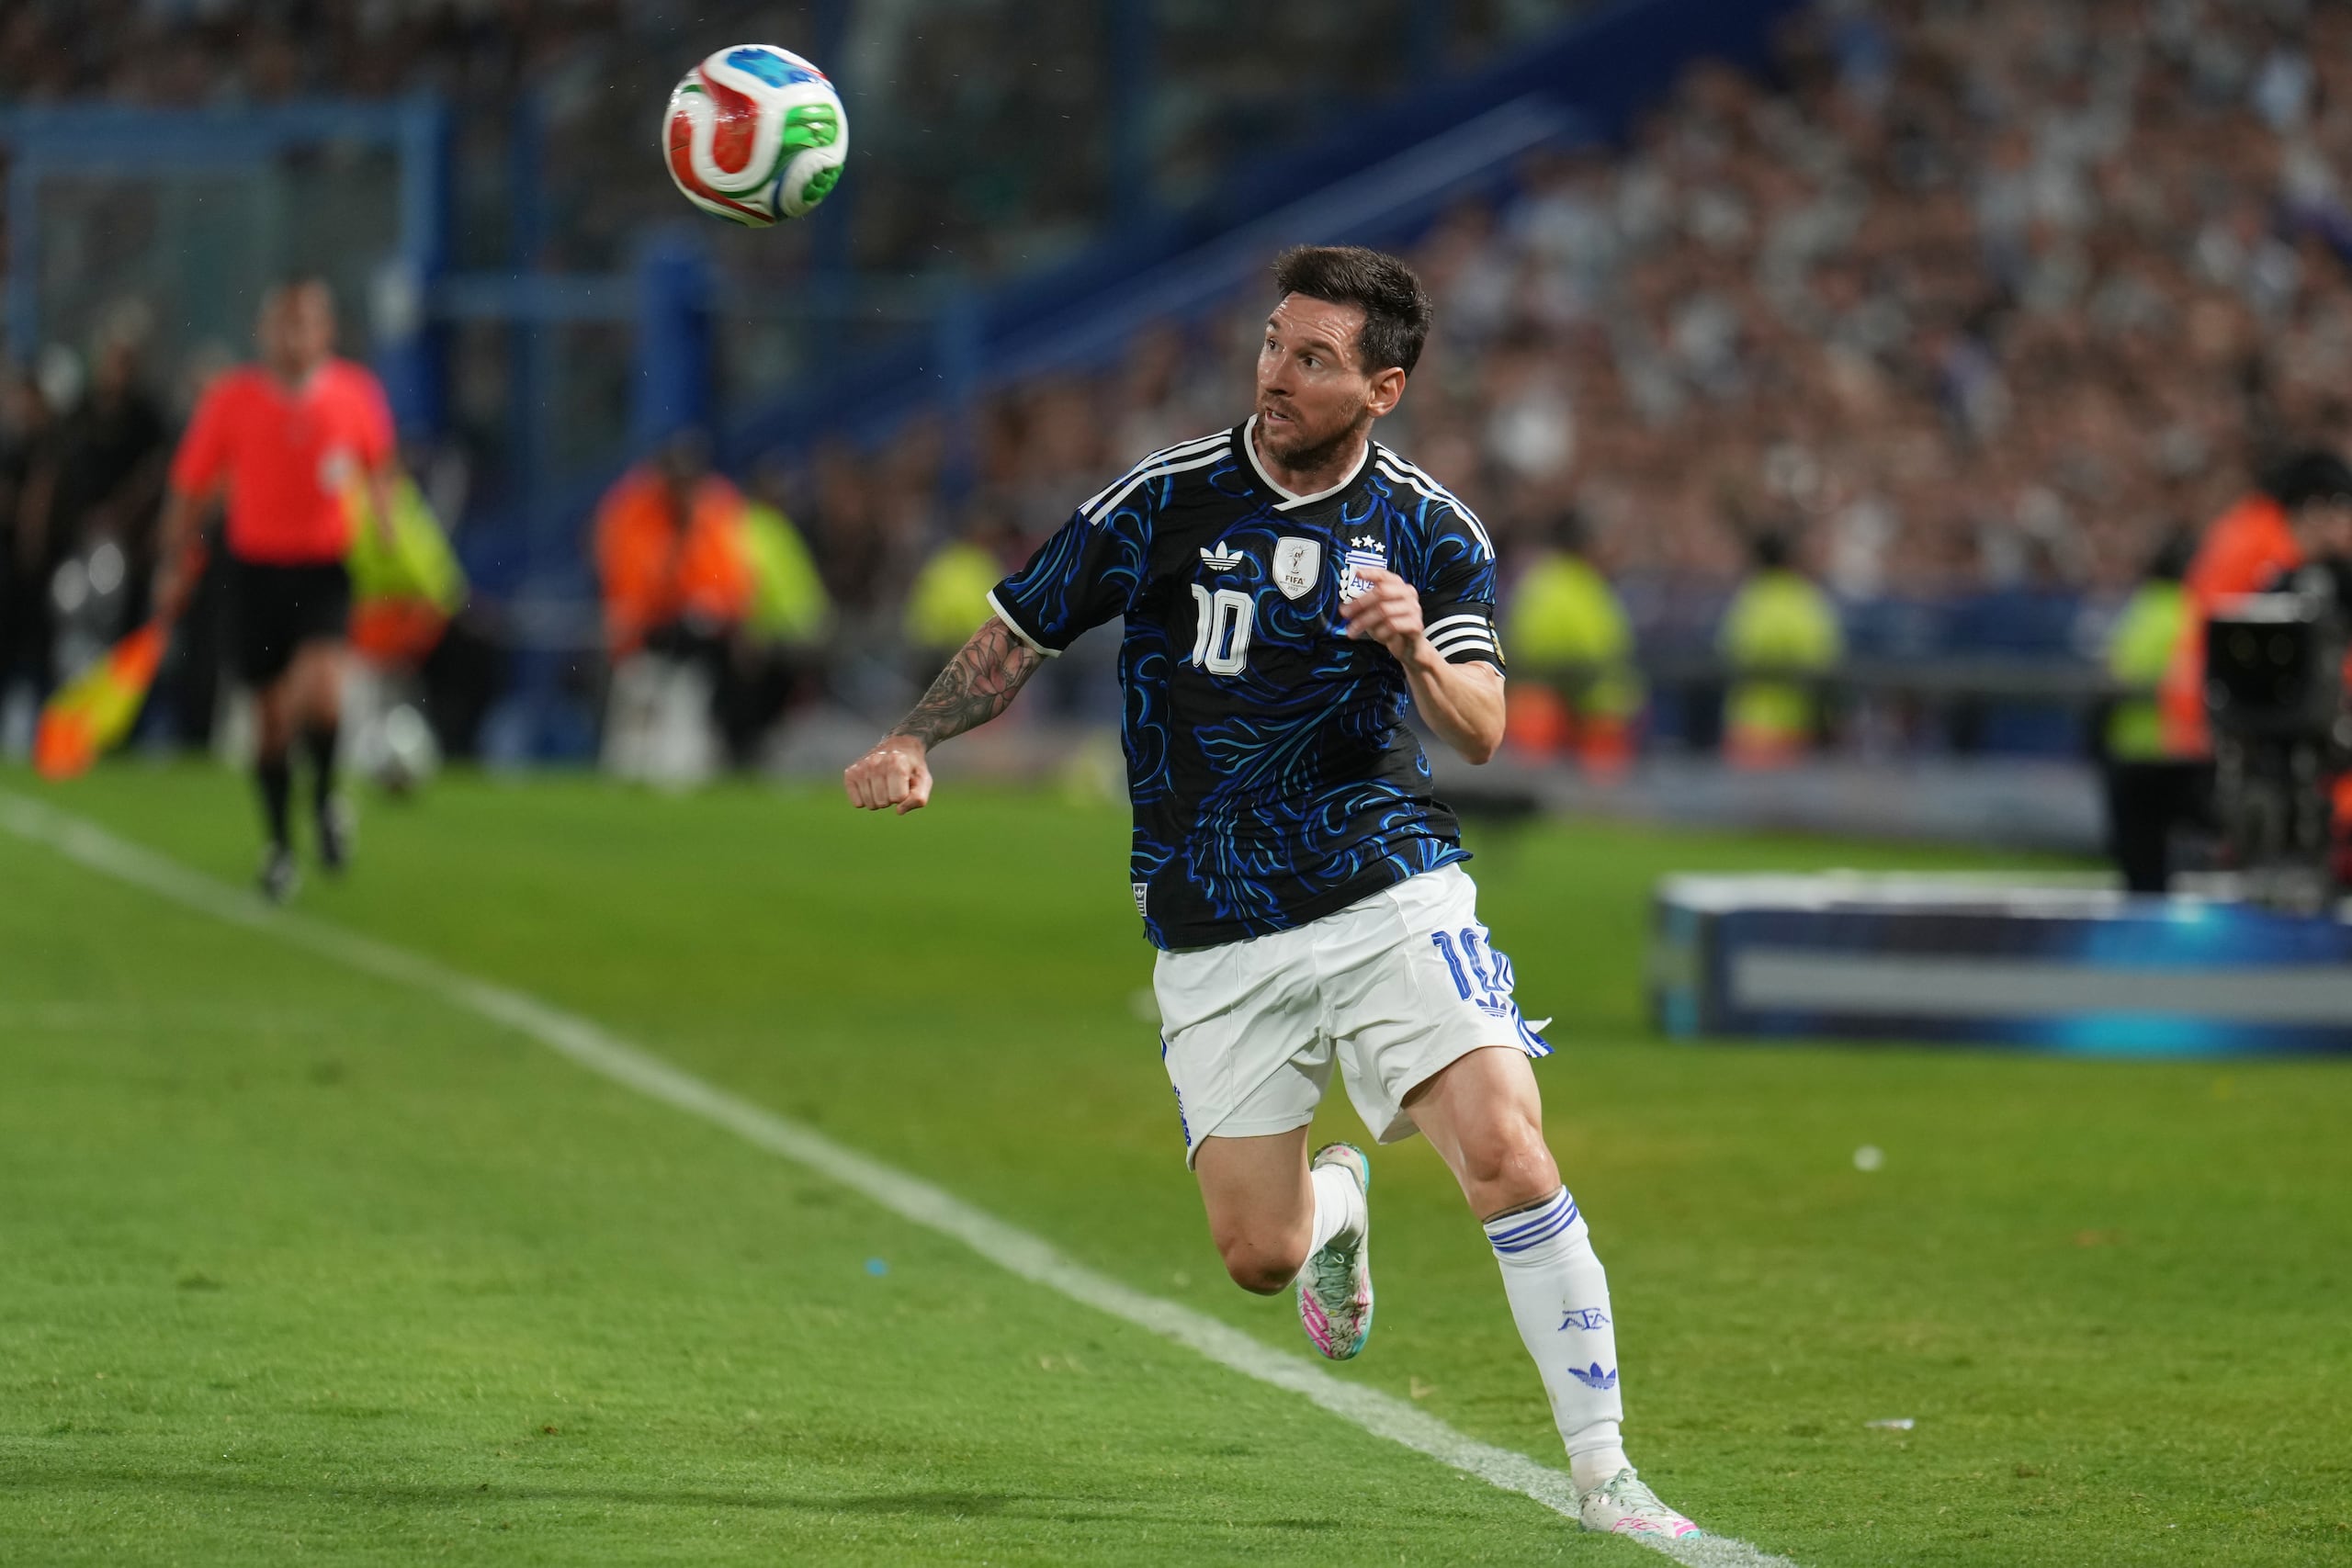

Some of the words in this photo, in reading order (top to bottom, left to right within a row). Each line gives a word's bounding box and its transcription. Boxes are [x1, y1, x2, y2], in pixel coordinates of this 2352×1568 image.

[1285, 575, 1304, 585] FIFA
[1191, 582, 1256, 676] 10
[1430, 928, 1507, 1001] 10
